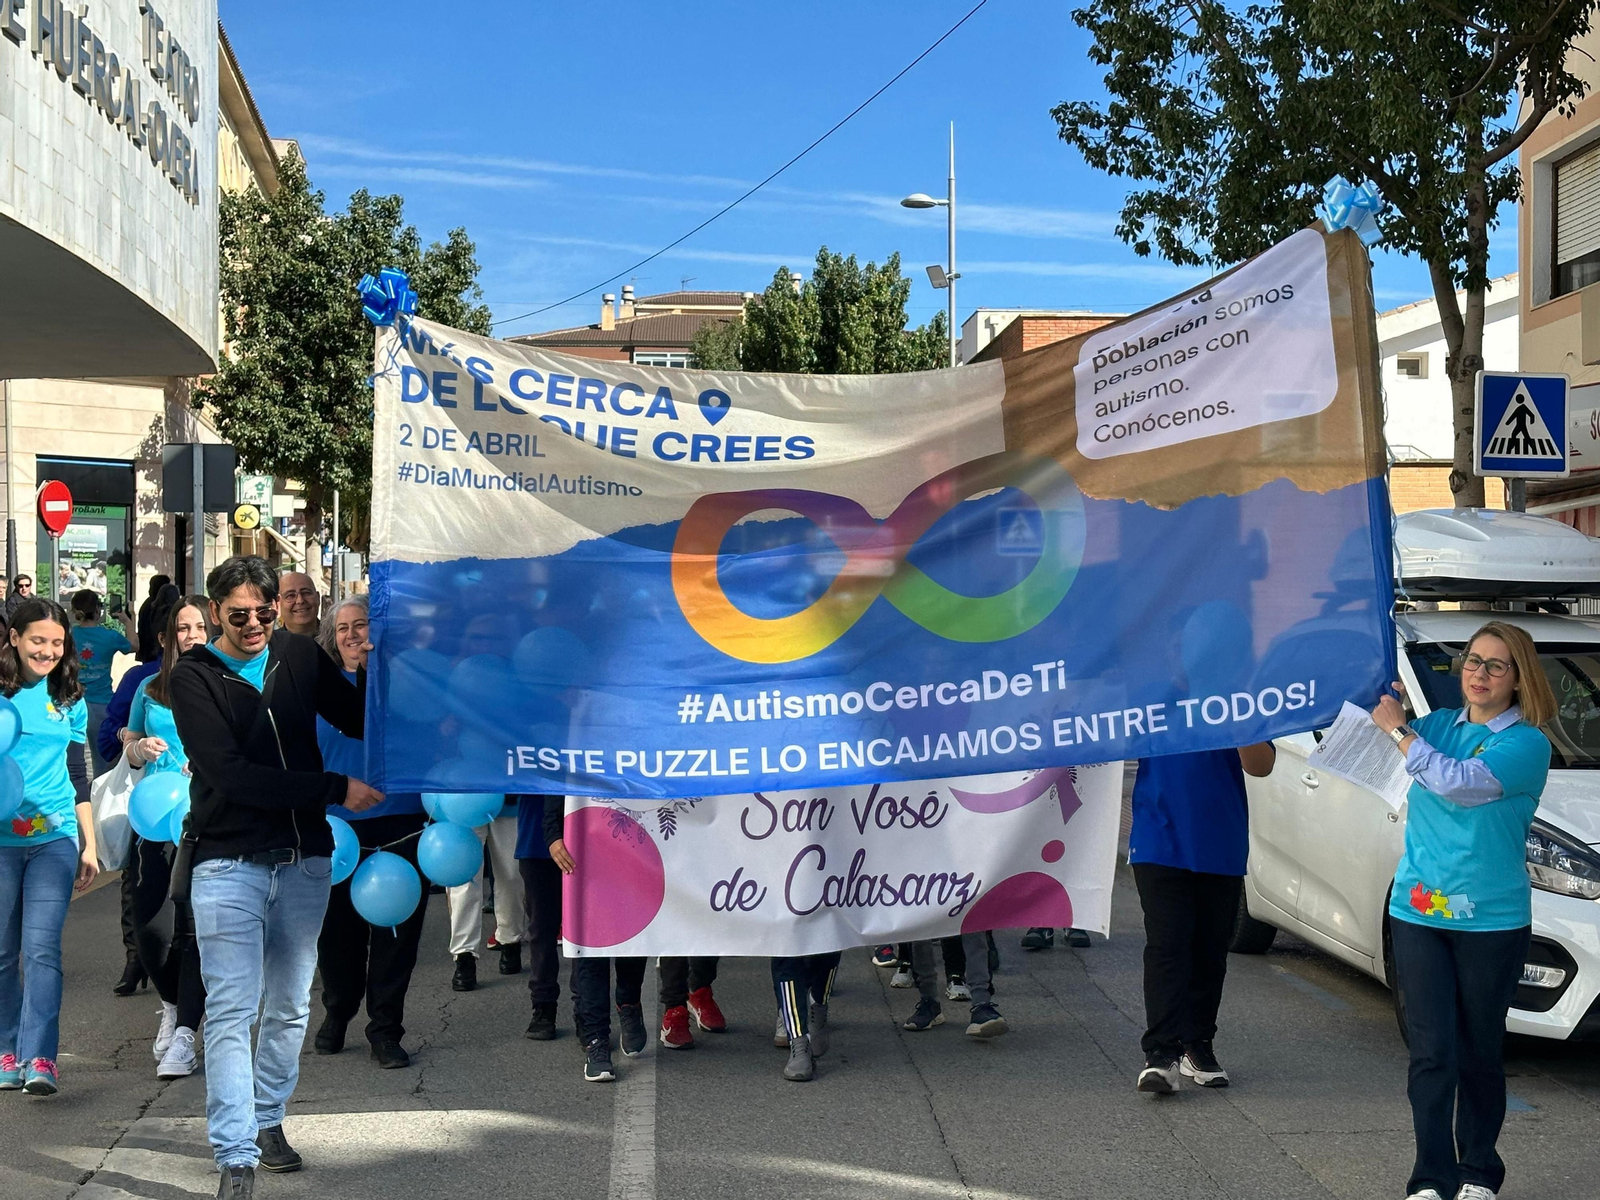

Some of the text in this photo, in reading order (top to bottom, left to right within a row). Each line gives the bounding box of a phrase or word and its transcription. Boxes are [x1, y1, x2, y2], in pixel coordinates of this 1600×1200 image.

[0, 0, 26, 41] E
[138, 0, 199, 122] TEATRO
[1092, 284, 1294, 373] población somos
[1094, 328, 1249, 394] personas con
[401, 365, 457, 409] DE
[652, 431, 816, 463] CREES
[509, 368, 678, 421] CERCA
[1095, 378, 1190, 418] autismo.
[399, 424, 546, 458] 2 DE ABRIL
[1094, 400, 1235, 443] Conócenos.
[398, 462, 643, 497] #DiaMundialAutismo
[73, 505, 106, 514] roBank
[677, 660, 1066, 723] #AutismoCercaDeTi
[507, 679, 1315, 778] ¡ESTE PUZZLE LO ENCAJAMOS ENTRE TODOS!
[740, 792, 835, 840] San
[709, 844, 981, 917] de Calasanz
